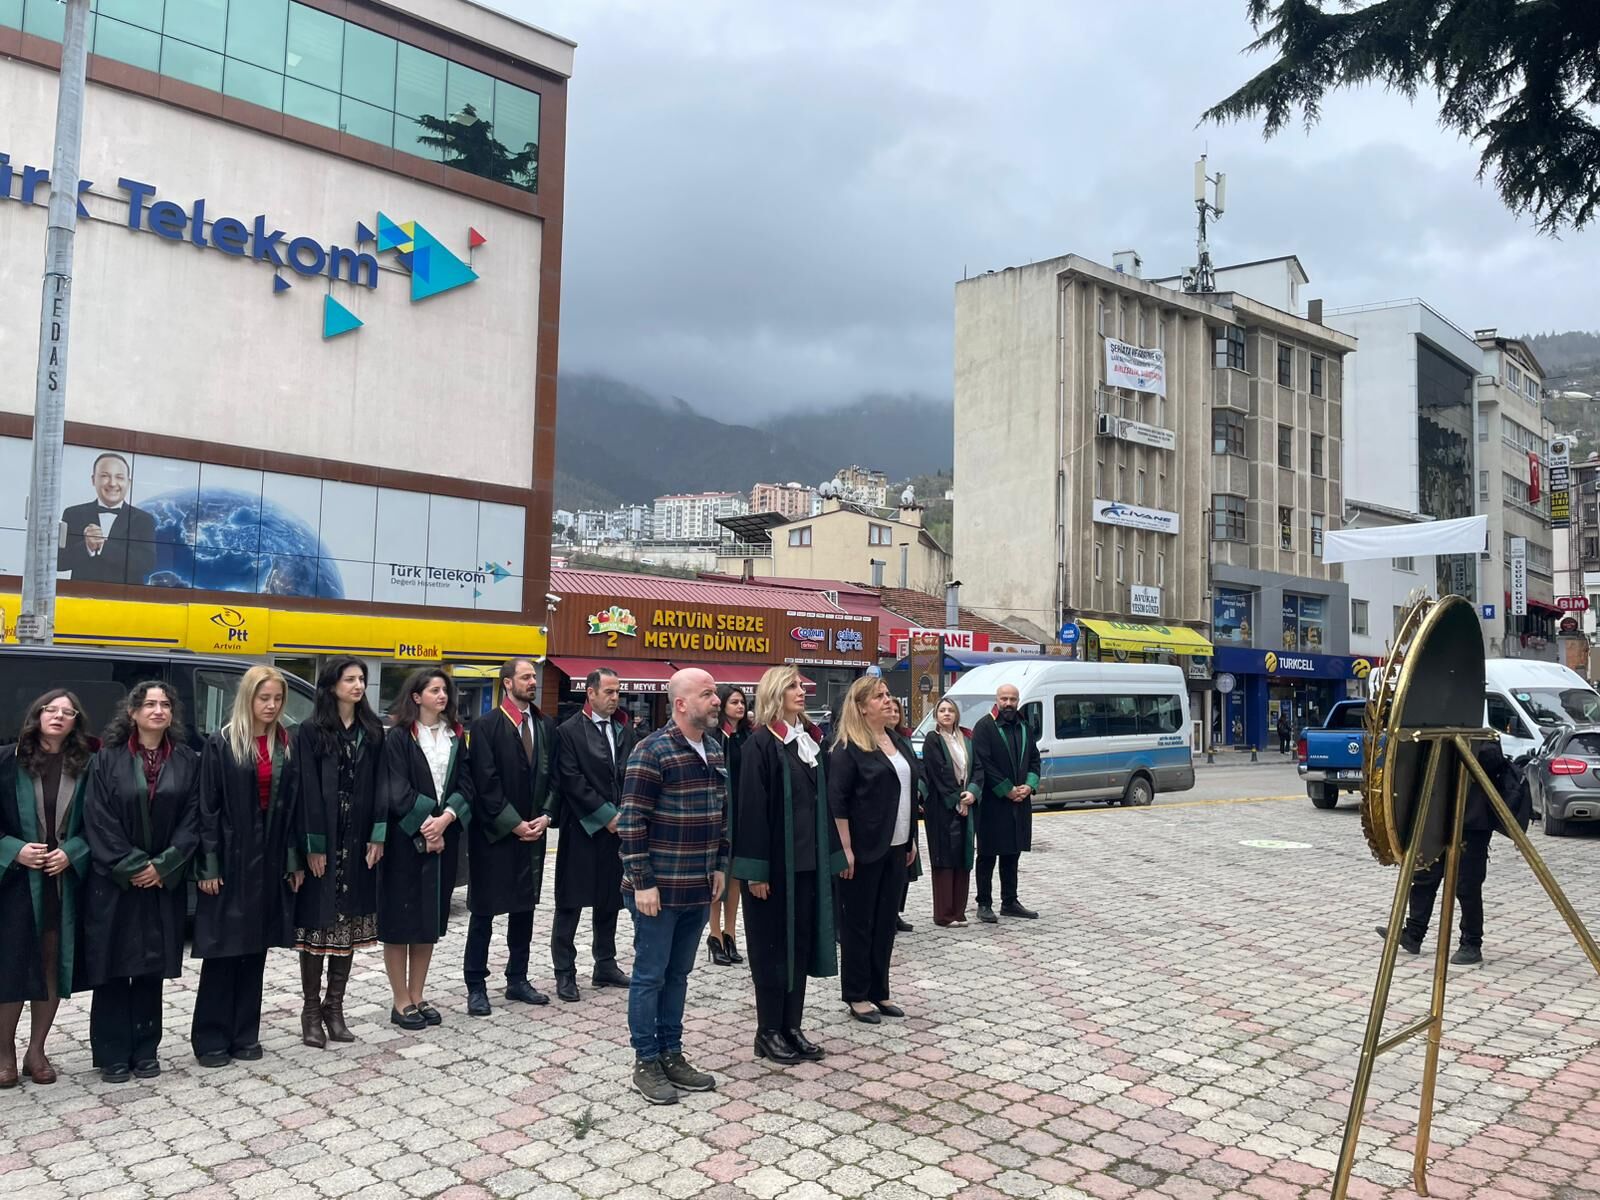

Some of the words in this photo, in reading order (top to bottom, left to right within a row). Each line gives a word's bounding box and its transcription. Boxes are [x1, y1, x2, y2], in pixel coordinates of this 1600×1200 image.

[117, 177, 379, 289] Telekom
[389, 563, 421, 578] Türk
[426, 566, 485, 584] Telekom
[1134, 593, 1158, 604] AVUKAT
[717, 614, 764, 633] SEBZE
[228, 628, 248, 641] Ptt
[607, 631, 618, 647] 2
[644, 631, 700, 650] MEYVE
[703, 632, 770, 653] DÜNYASI
[912, 631, 971, 648] ECZANE
[1279, 658, 1314, 671] TURKCELL
[634, 683, 656, 691] MEYVE
